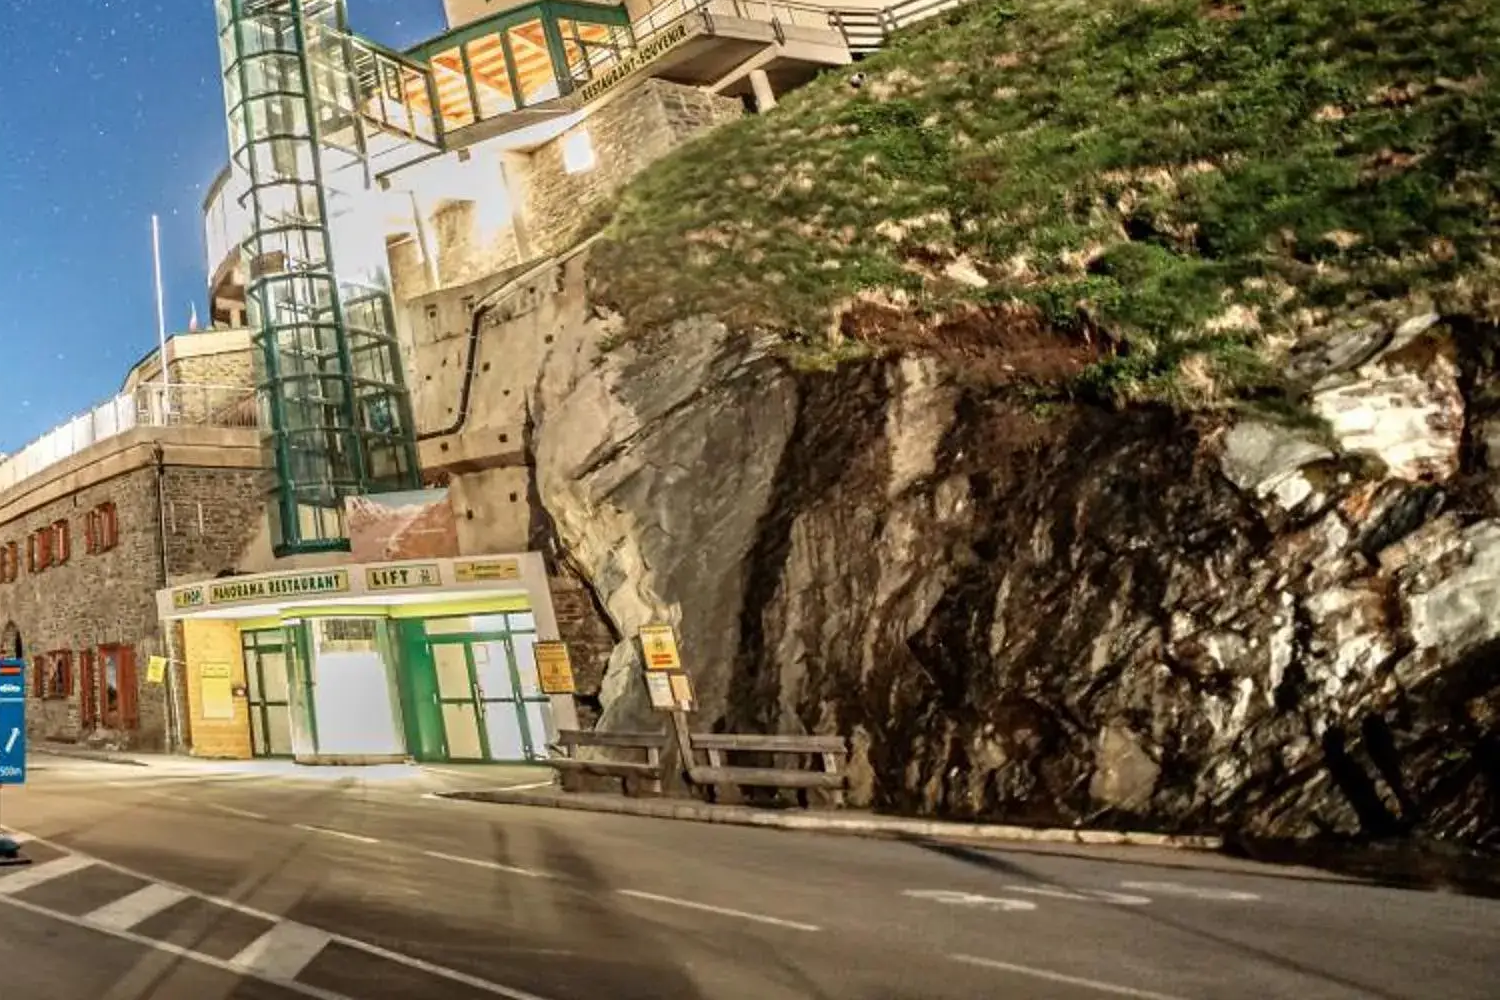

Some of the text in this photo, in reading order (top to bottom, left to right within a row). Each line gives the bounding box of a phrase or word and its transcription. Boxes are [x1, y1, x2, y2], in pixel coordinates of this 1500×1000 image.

[213, 574, 340, 600] PANORAMA RESTAURANT
[372, 569, 409, 586] LIFT
